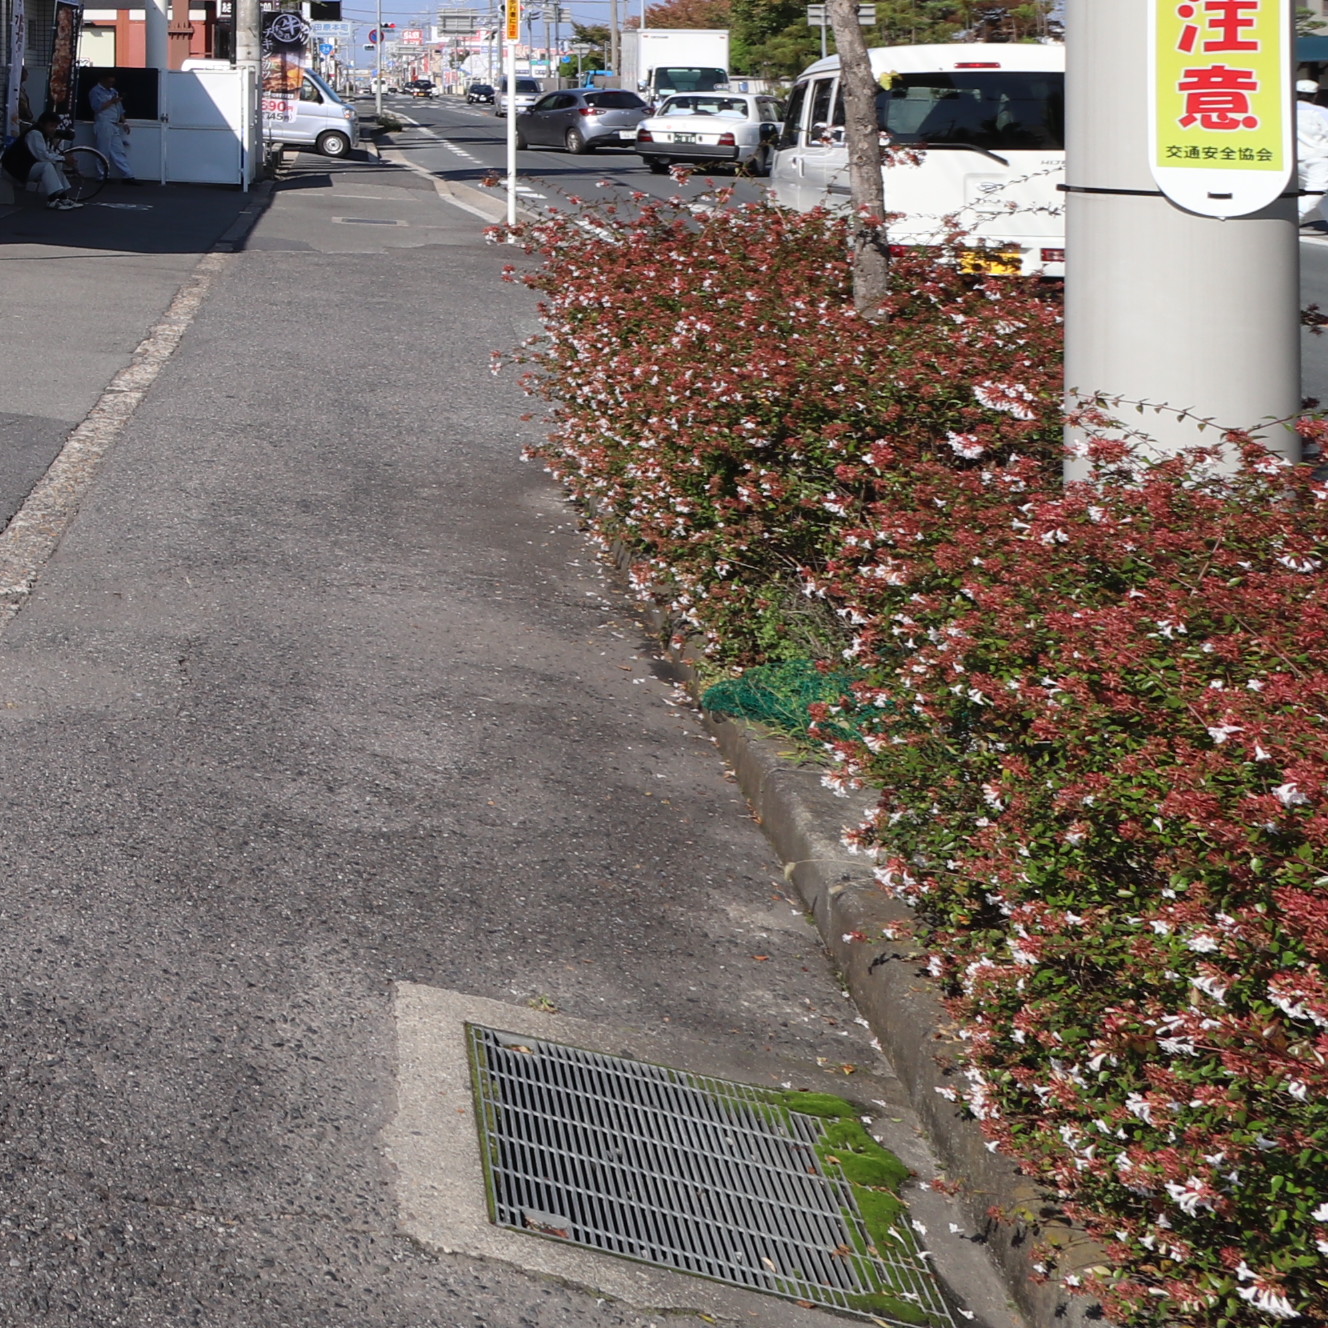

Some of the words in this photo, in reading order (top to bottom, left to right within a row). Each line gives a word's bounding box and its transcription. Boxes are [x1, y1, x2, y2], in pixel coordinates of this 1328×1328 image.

[1166, 144, 1274, 162] 交通安全協会
